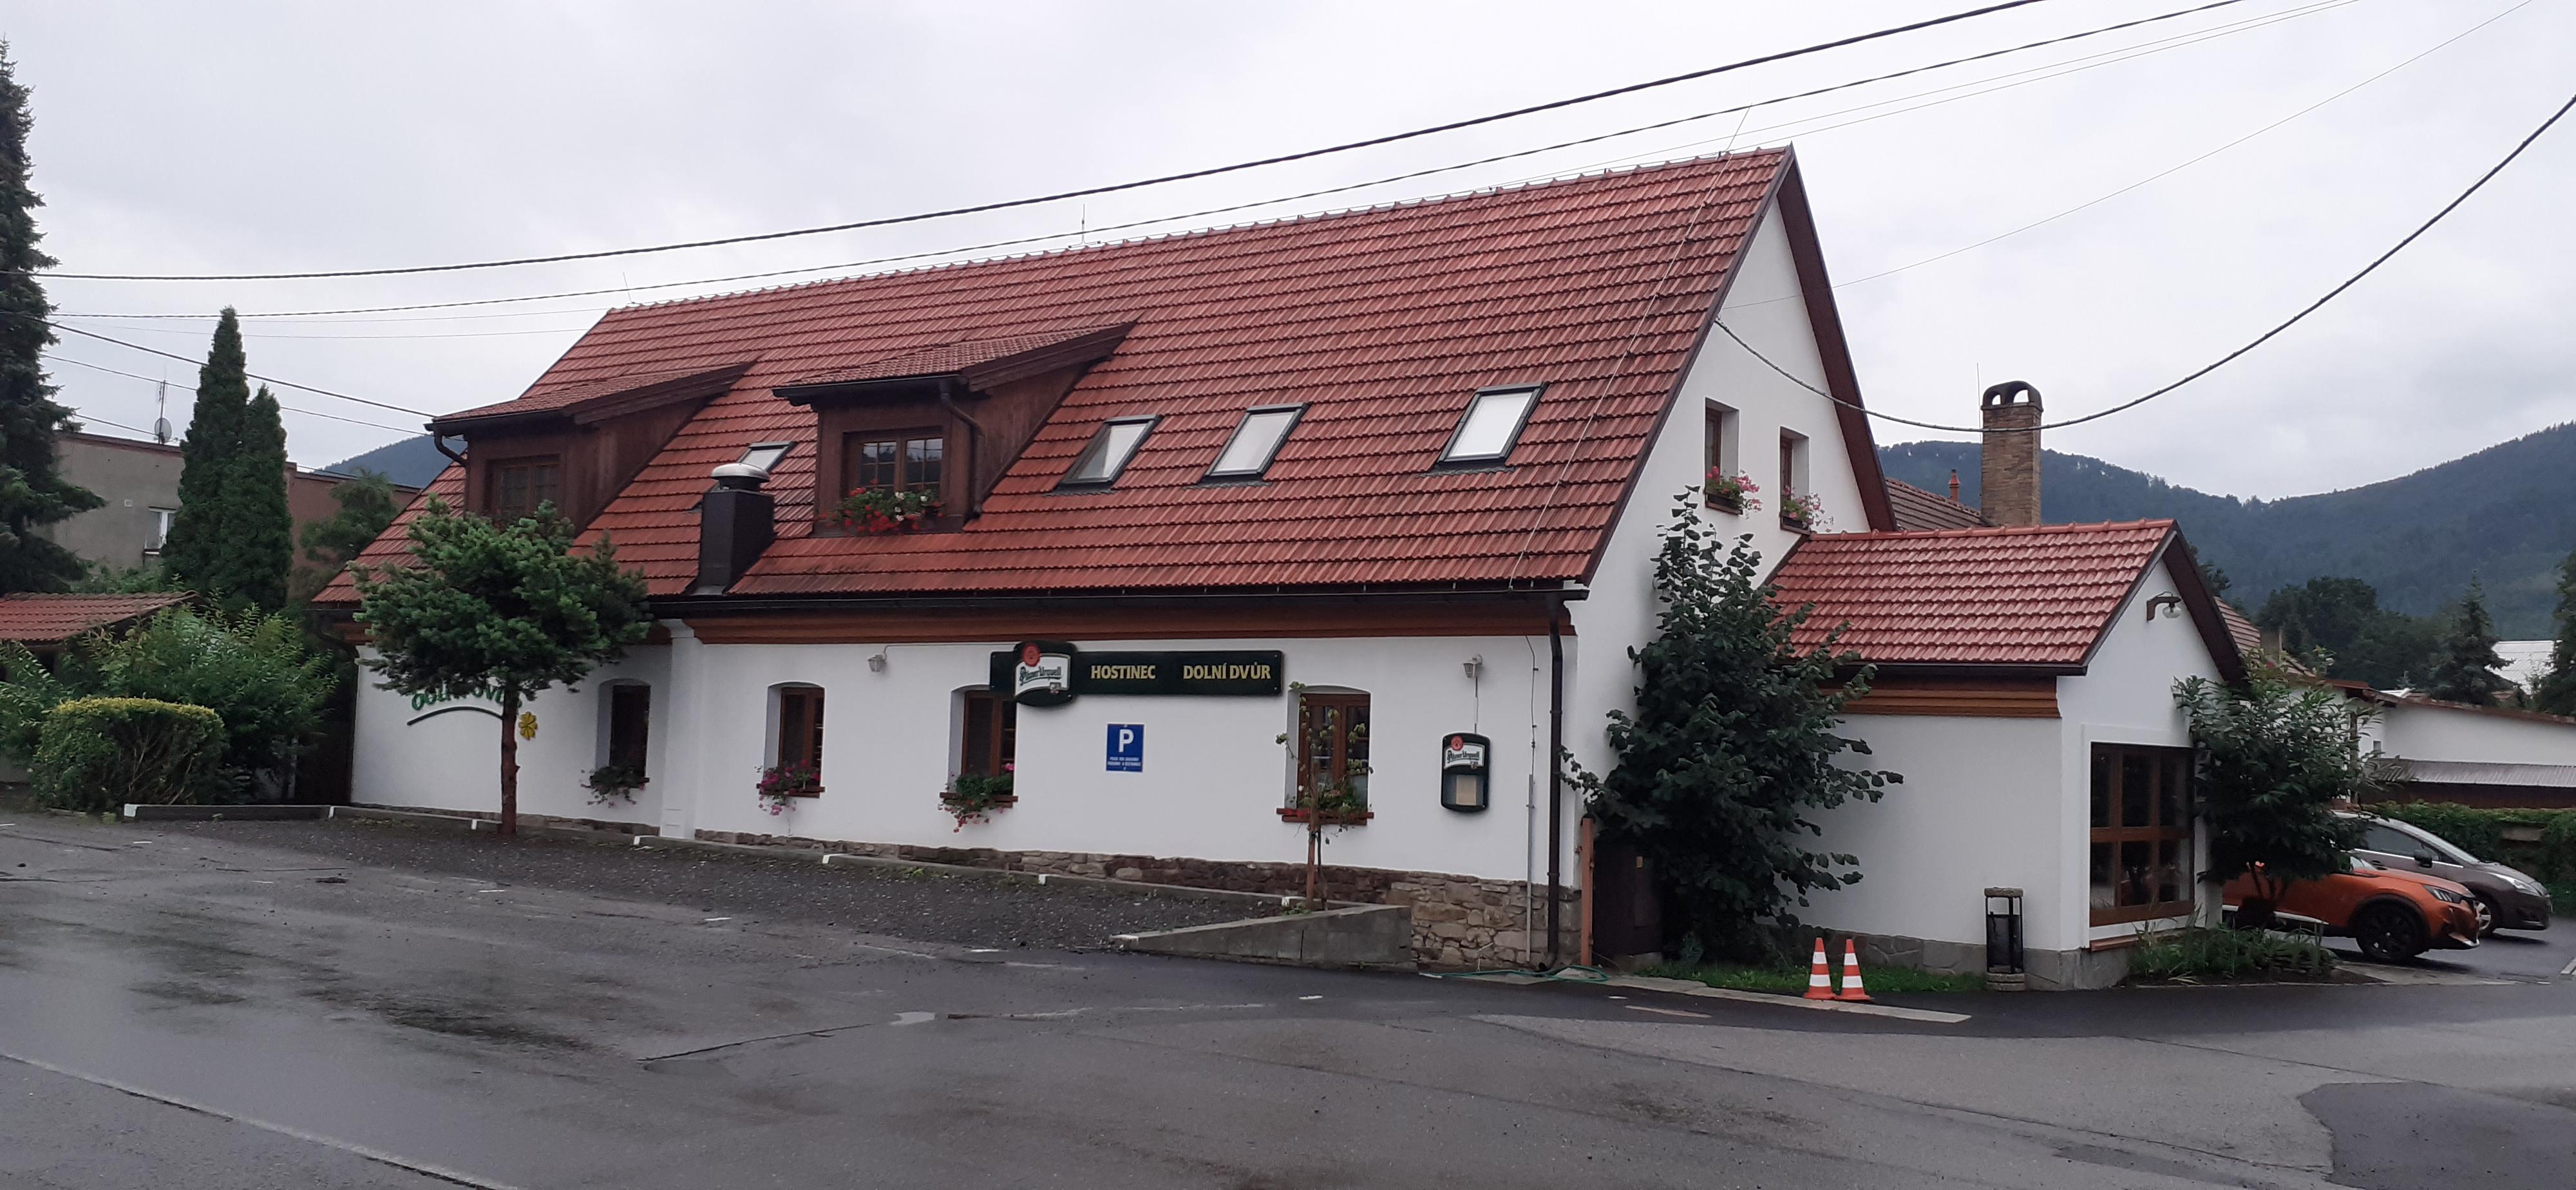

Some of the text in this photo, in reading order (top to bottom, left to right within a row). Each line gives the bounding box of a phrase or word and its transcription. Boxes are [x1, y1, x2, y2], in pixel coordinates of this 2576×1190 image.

[1090, 661, 1271, 679] HOSTINEC DOLNÍ DVŮR
[1119, 729, 1134, 753] P
